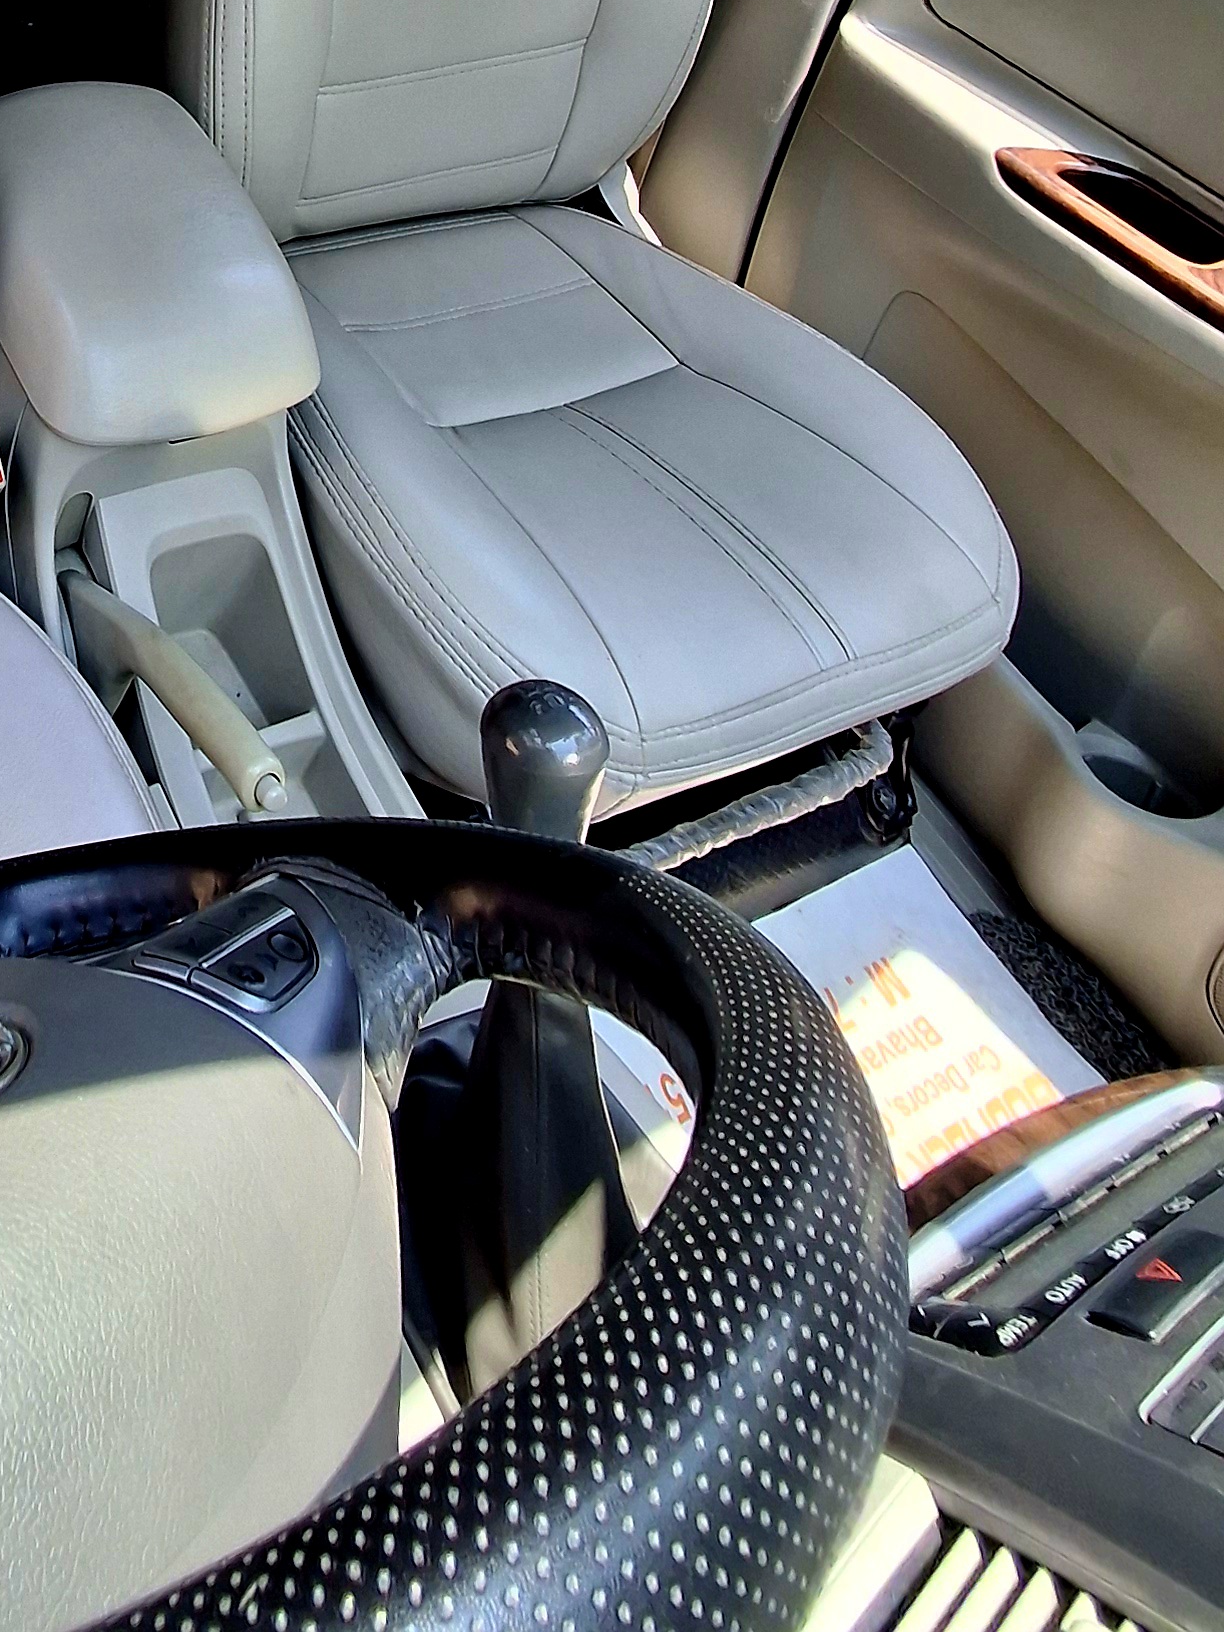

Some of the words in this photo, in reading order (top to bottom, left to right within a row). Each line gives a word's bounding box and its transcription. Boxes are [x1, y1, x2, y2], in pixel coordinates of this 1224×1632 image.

[963, 1044, 1001, 1076] Car
[1045, 1272, 1088, 1304] AUTO
[996, 1314, 1039, 1347] TEMP
